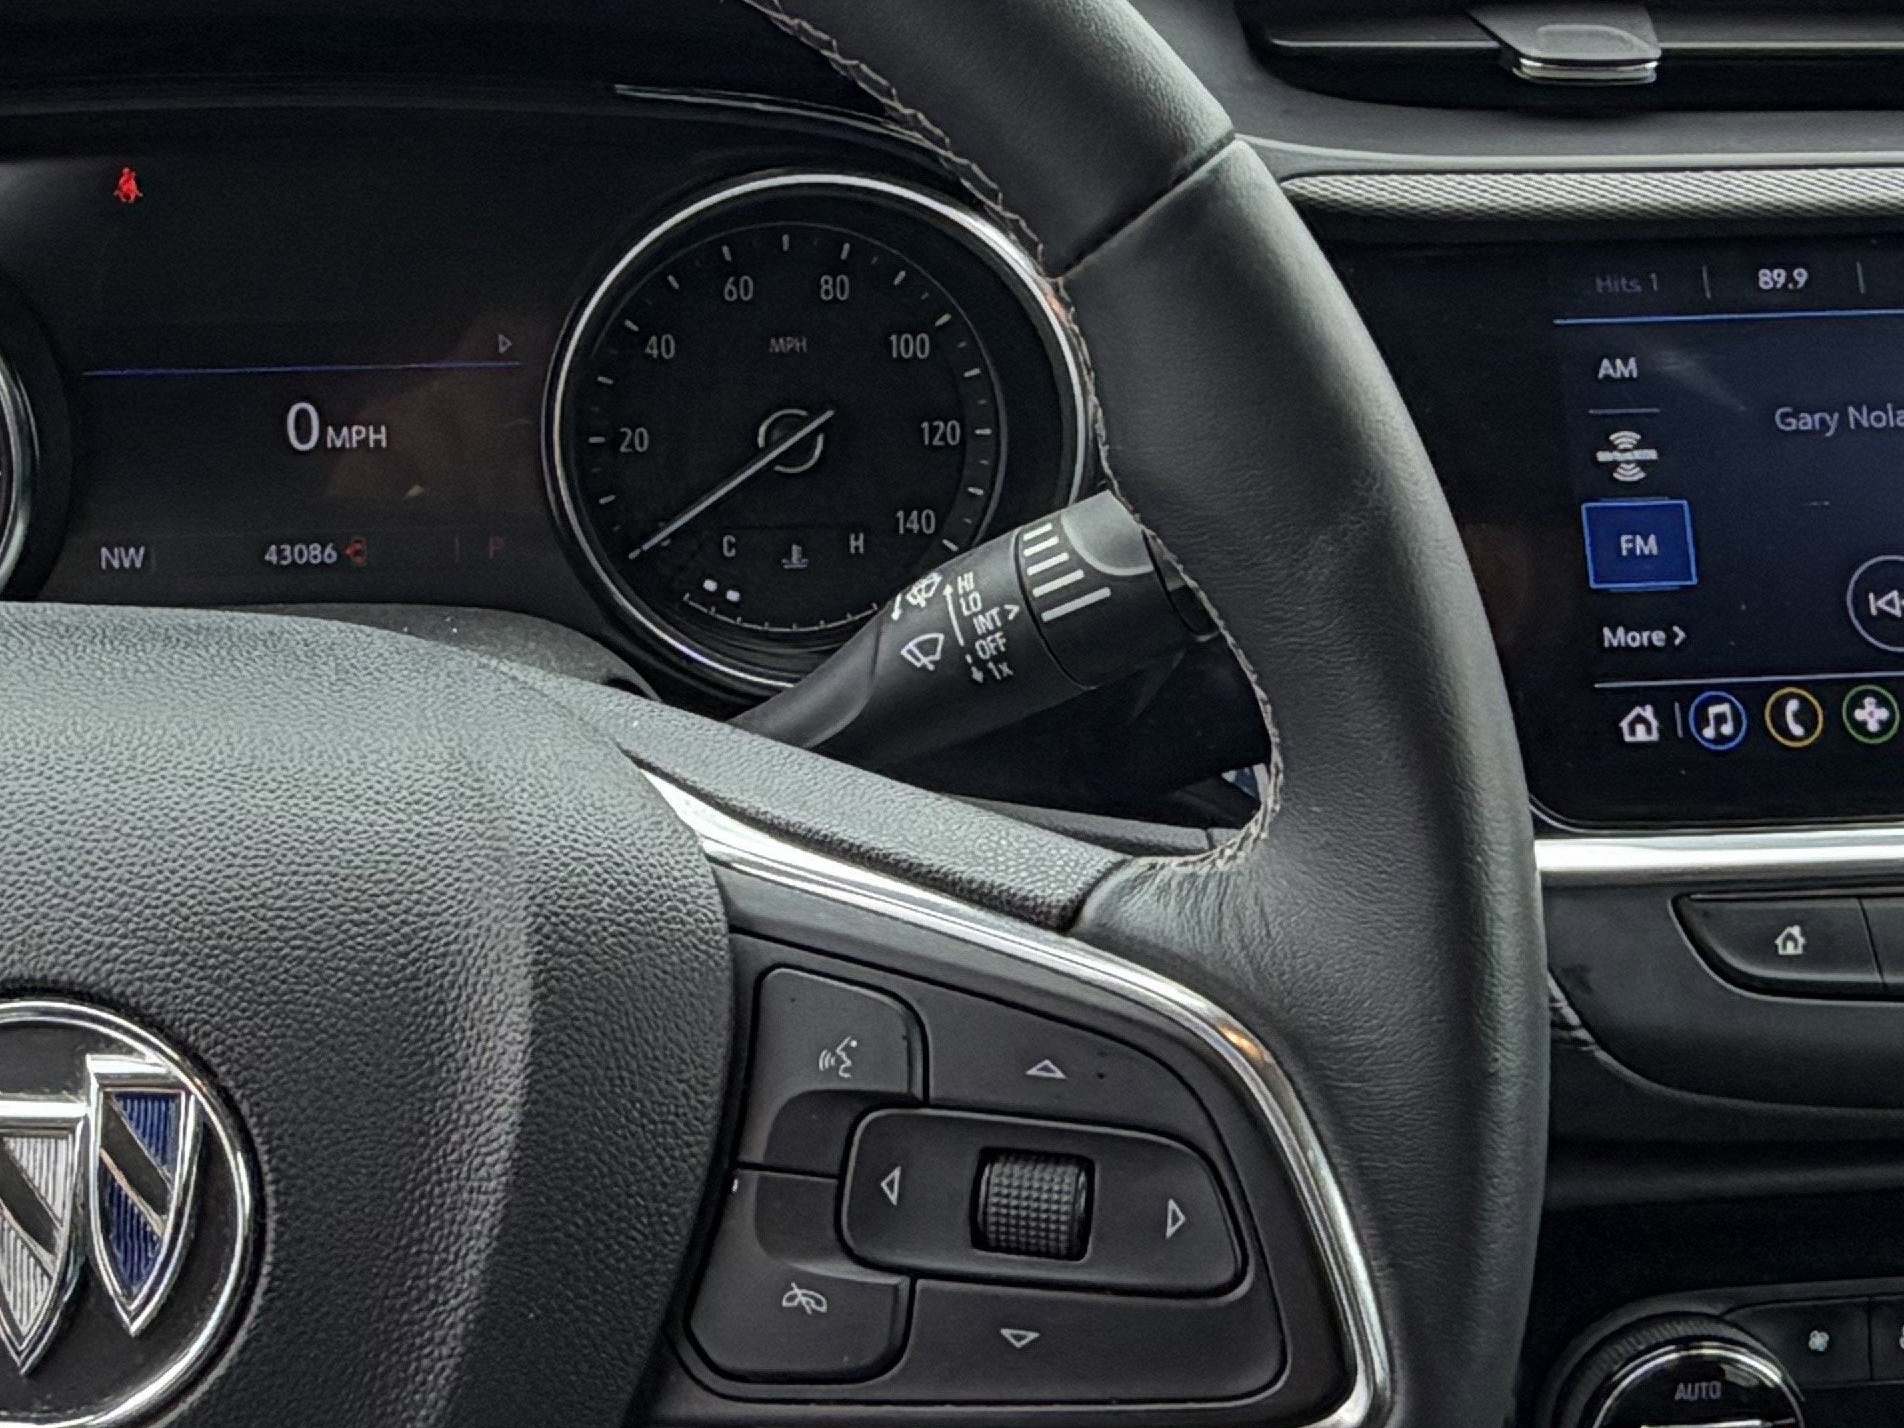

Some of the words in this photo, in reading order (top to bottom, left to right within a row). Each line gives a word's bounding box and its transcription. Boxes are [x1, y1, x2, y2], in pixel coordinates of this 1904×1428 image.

[723, 276, 754, 302] 60
[819, 275, 850, 303] 80
[1757, 267, 1809, 290] 89.9
[644, 333, 677, 360] 40
[768, 336, 809, 355] MPH
[888, 333, 931, 359] 100
[1598, 358, 1638, 379] AM
[286, 401, 321, 452] 0
[326, 424, 388, 449] MPH
[919, 420, 962, 447] 120
[1774, 405, 1839, 438] Gary
[618, 426, 650, 454] 20
[895, 509, 938, 536] 140
[264, 542, 337, 567] 43086
[721, 534, 737, 558] C
[849, 532, 865, 556] H
[1619, 534, 1659, 557] FM
[99, 545, 145, 571] NW
[957, 570, 976, 596] HI
[959, 590, 983, 617] LO
[972, 606, 1002, 636] INT
[974, 630, 1007, 660] OFF
[1602, 626, 1667, 649] More
[1674, 1379, 1723, 1401] AUTO
